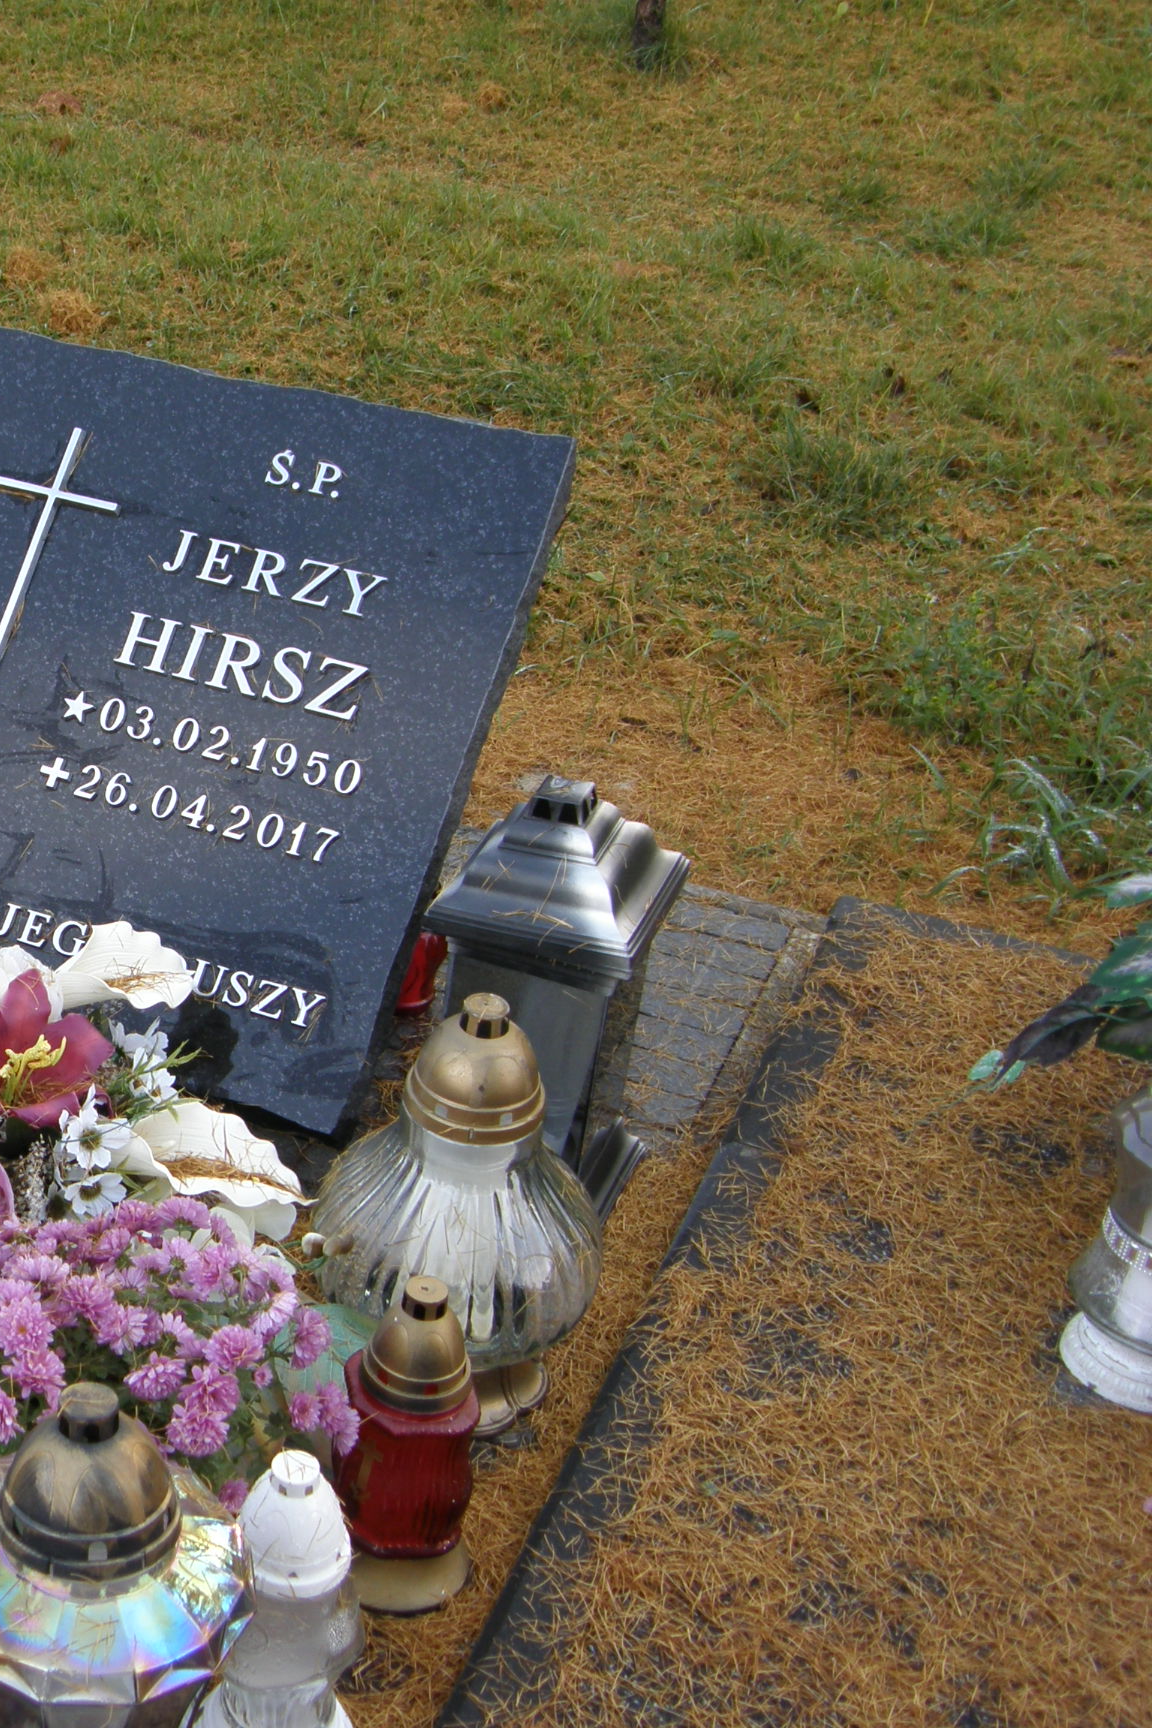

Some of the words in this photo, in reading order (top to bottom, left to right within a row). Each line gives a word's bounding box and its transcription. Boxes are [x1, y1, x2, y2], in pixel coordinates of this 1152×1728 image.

[162, 529, 388, 617] JERZY
[113, 611, 370, 721] HIRSZ
[99, 698, 362, 794] 03.02.1950
[74, 764, 340, 863] 26.04.2017
[193, 958, 328, 1028] USZY
